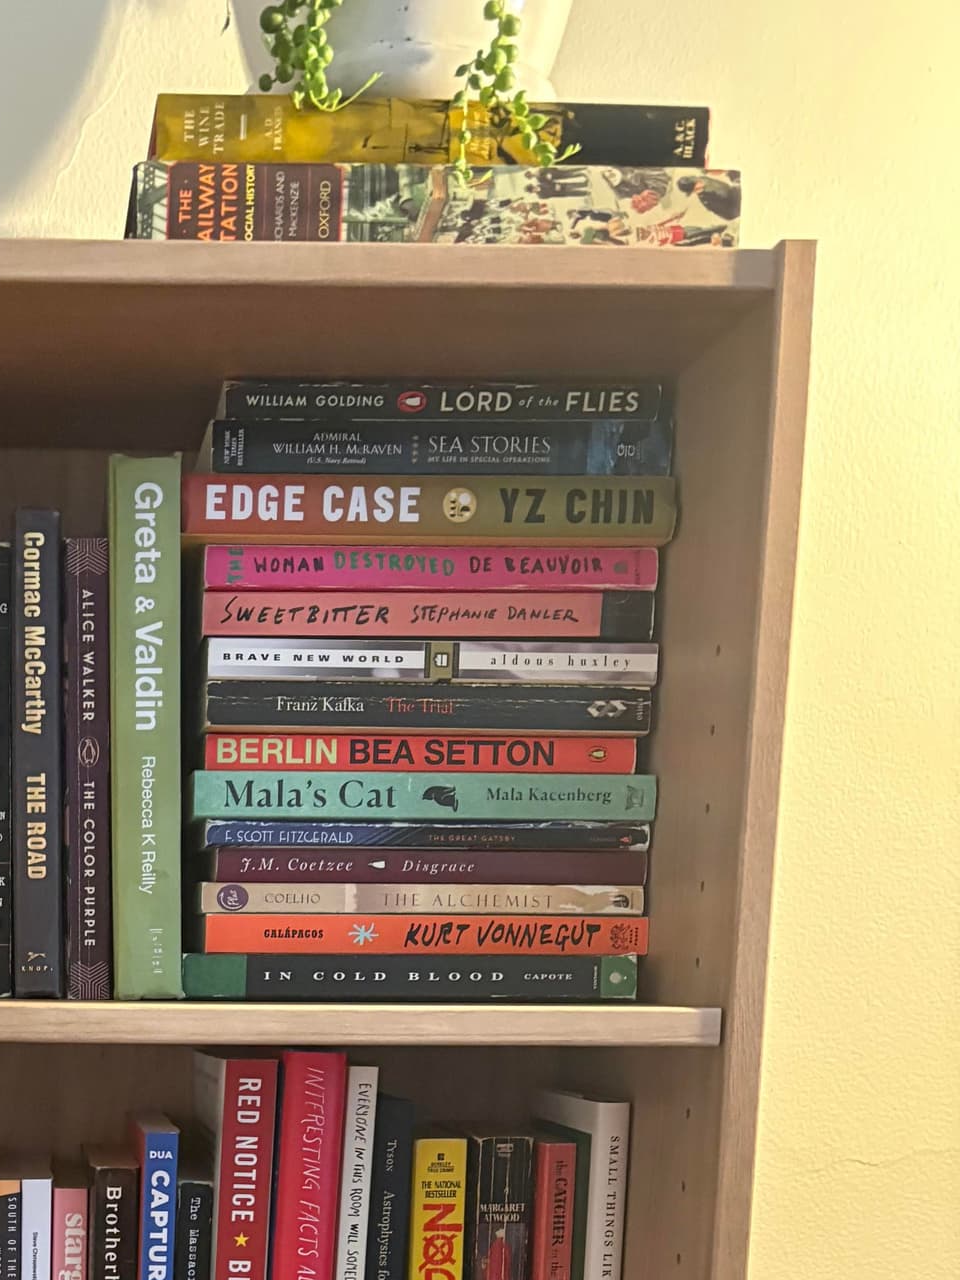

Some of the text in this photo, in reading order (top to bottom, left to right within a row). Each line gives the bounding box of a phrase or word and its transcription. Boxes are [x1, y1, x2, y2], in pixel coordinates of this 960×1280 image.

[179, 188, 193, 224] THE
[198, 164, 215, 240] AILWAY
[220, 164, 238, 240] TATION
[319, 180, 331, 238] OXFORD
[441, 392, 639, 412] LORD of the FLIES
[206, 484, 421, 522] EDGE CASE
[499, 488, 654, 524] YZ CHIN
[135, 483, 163, 731] Greta & Valdin
[21, 532, 46, 735] Cormac McCarthy
[223, 653, 404, 663] BRAVE NEW WORLD
[224, 779, 397, 808] Mala's Cat
[487, 788, 612, 805] Mala Kacenberg
[27, 773, 46, 879] THE ROAD
[84, 782, 95, 946] THE COLOR PURPLE
[402, 860, 475, 875] Disgrace
[264, 926, 324, 938] GALÁPAGOS
[405, 921, 601, 950] KURT VONNEGUT
[264, 971, 504, 981] IN COLD BLOOD
[232, 1078, 261, 1222] RED NOTICE
[301, 1067, 324, 1190] INTERESTING
[149, 1151, 172, 1159] DUA
[608, 1136, 619, 1185] SMALL
[298, 1200, 320, 1257] FACTS
[604, 1192, 616, 1247] THINGS
